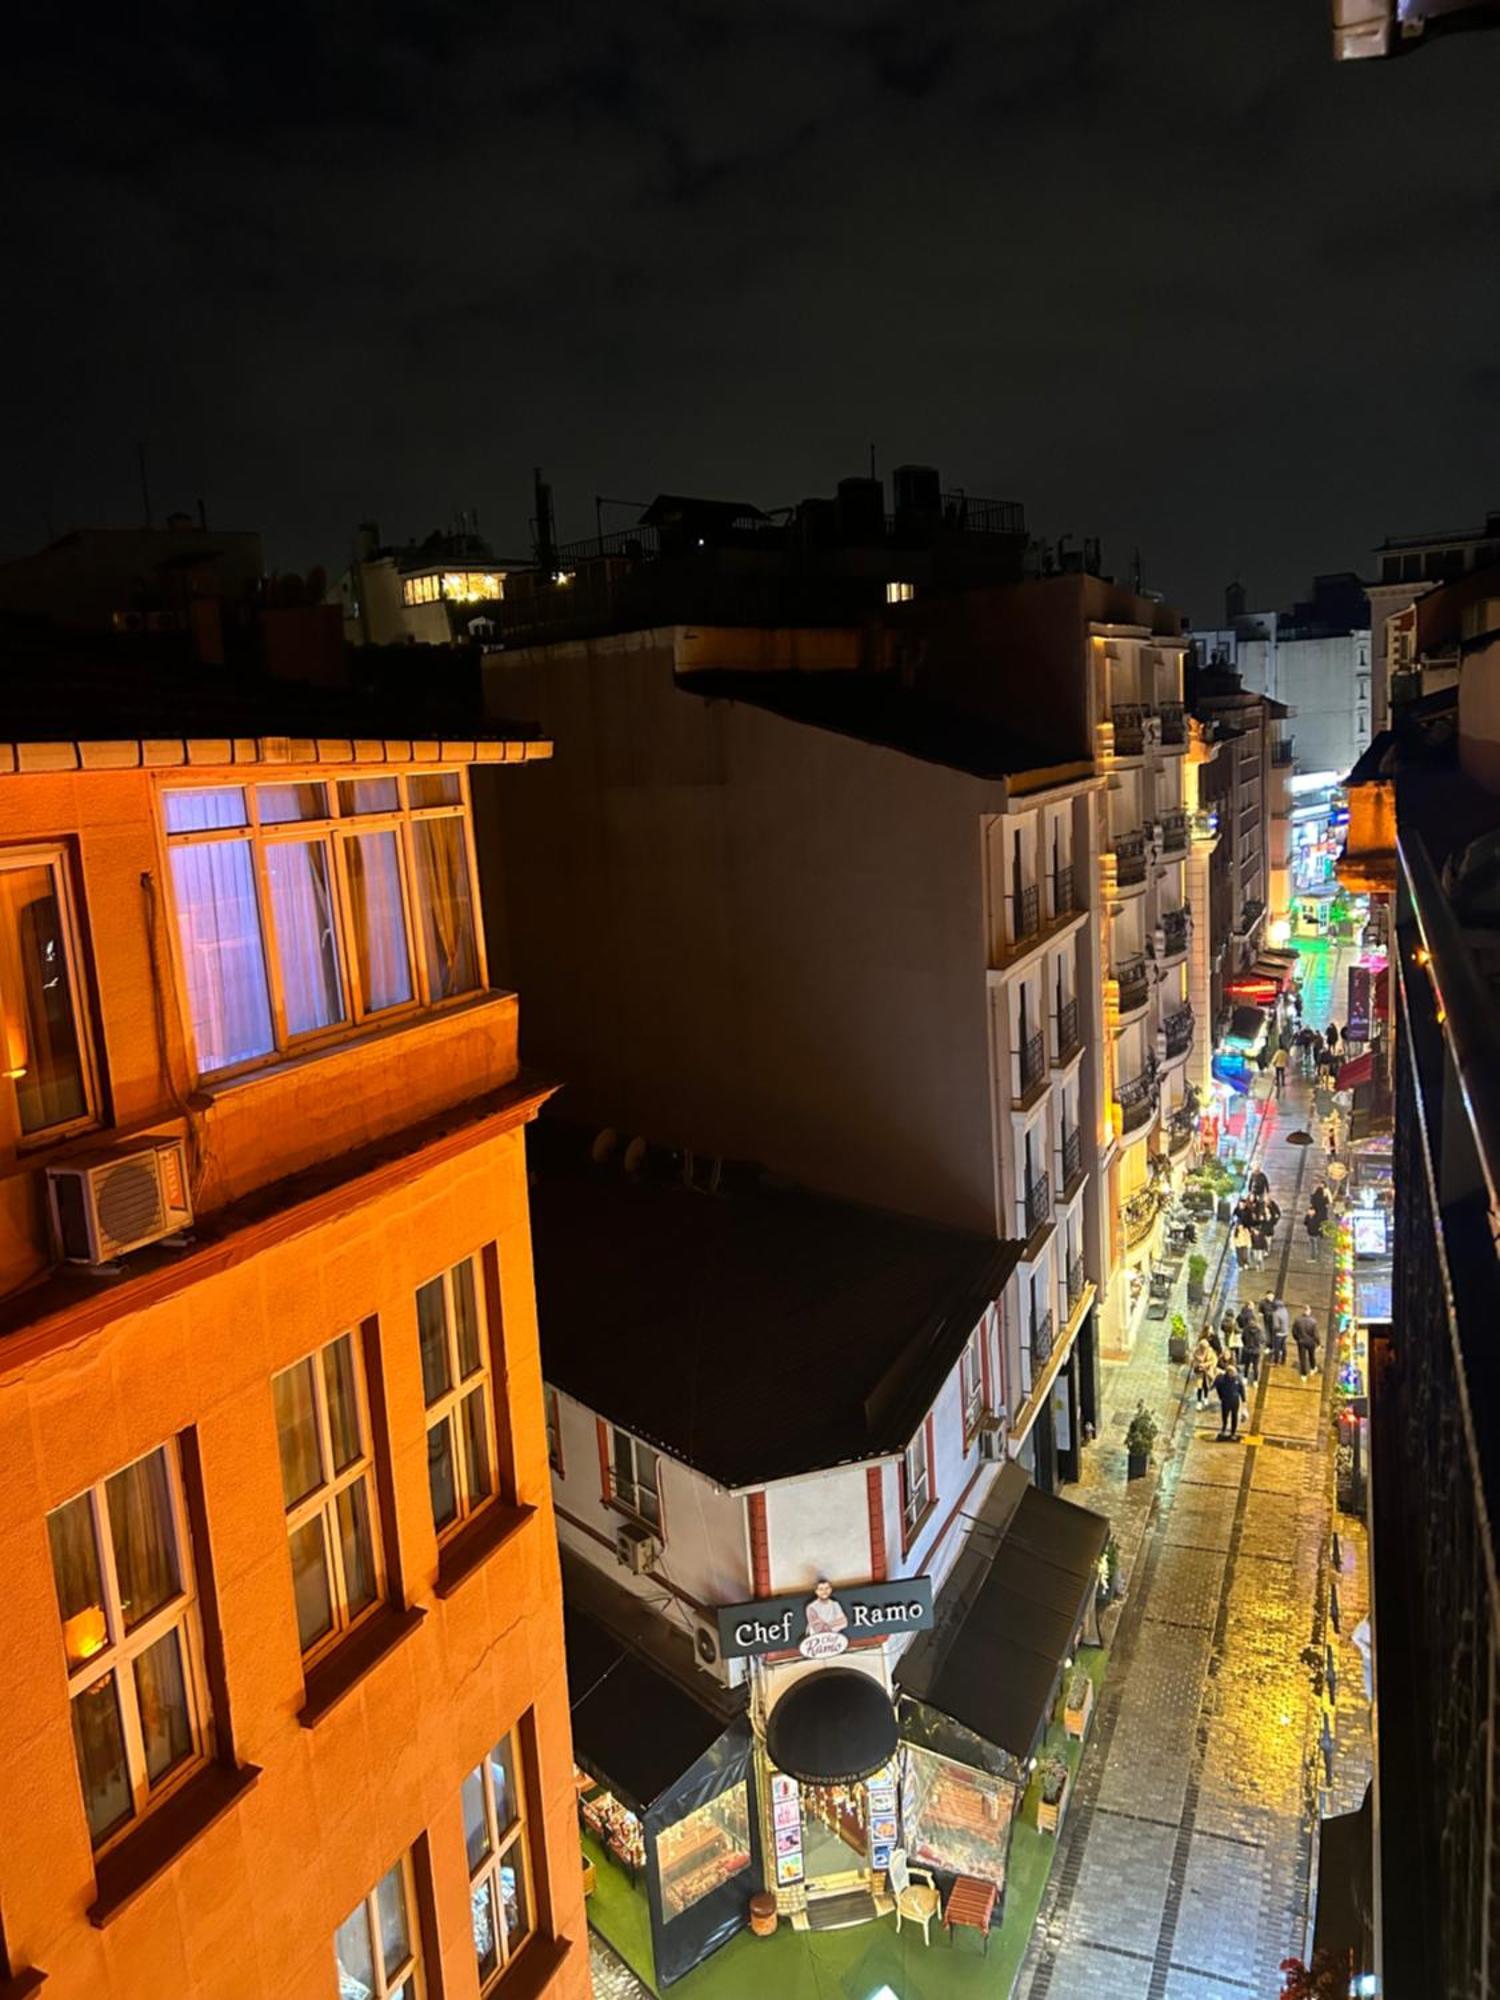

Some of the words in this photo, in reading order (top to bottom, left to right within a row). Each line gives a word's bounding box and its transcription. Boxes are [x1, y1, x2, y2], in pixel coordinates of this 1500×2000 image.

[735, 1612, 793, 1647] Chef
[852, 1602, 924, 1628] Ramo
[805, 1638, 842, 1656] Ramo
